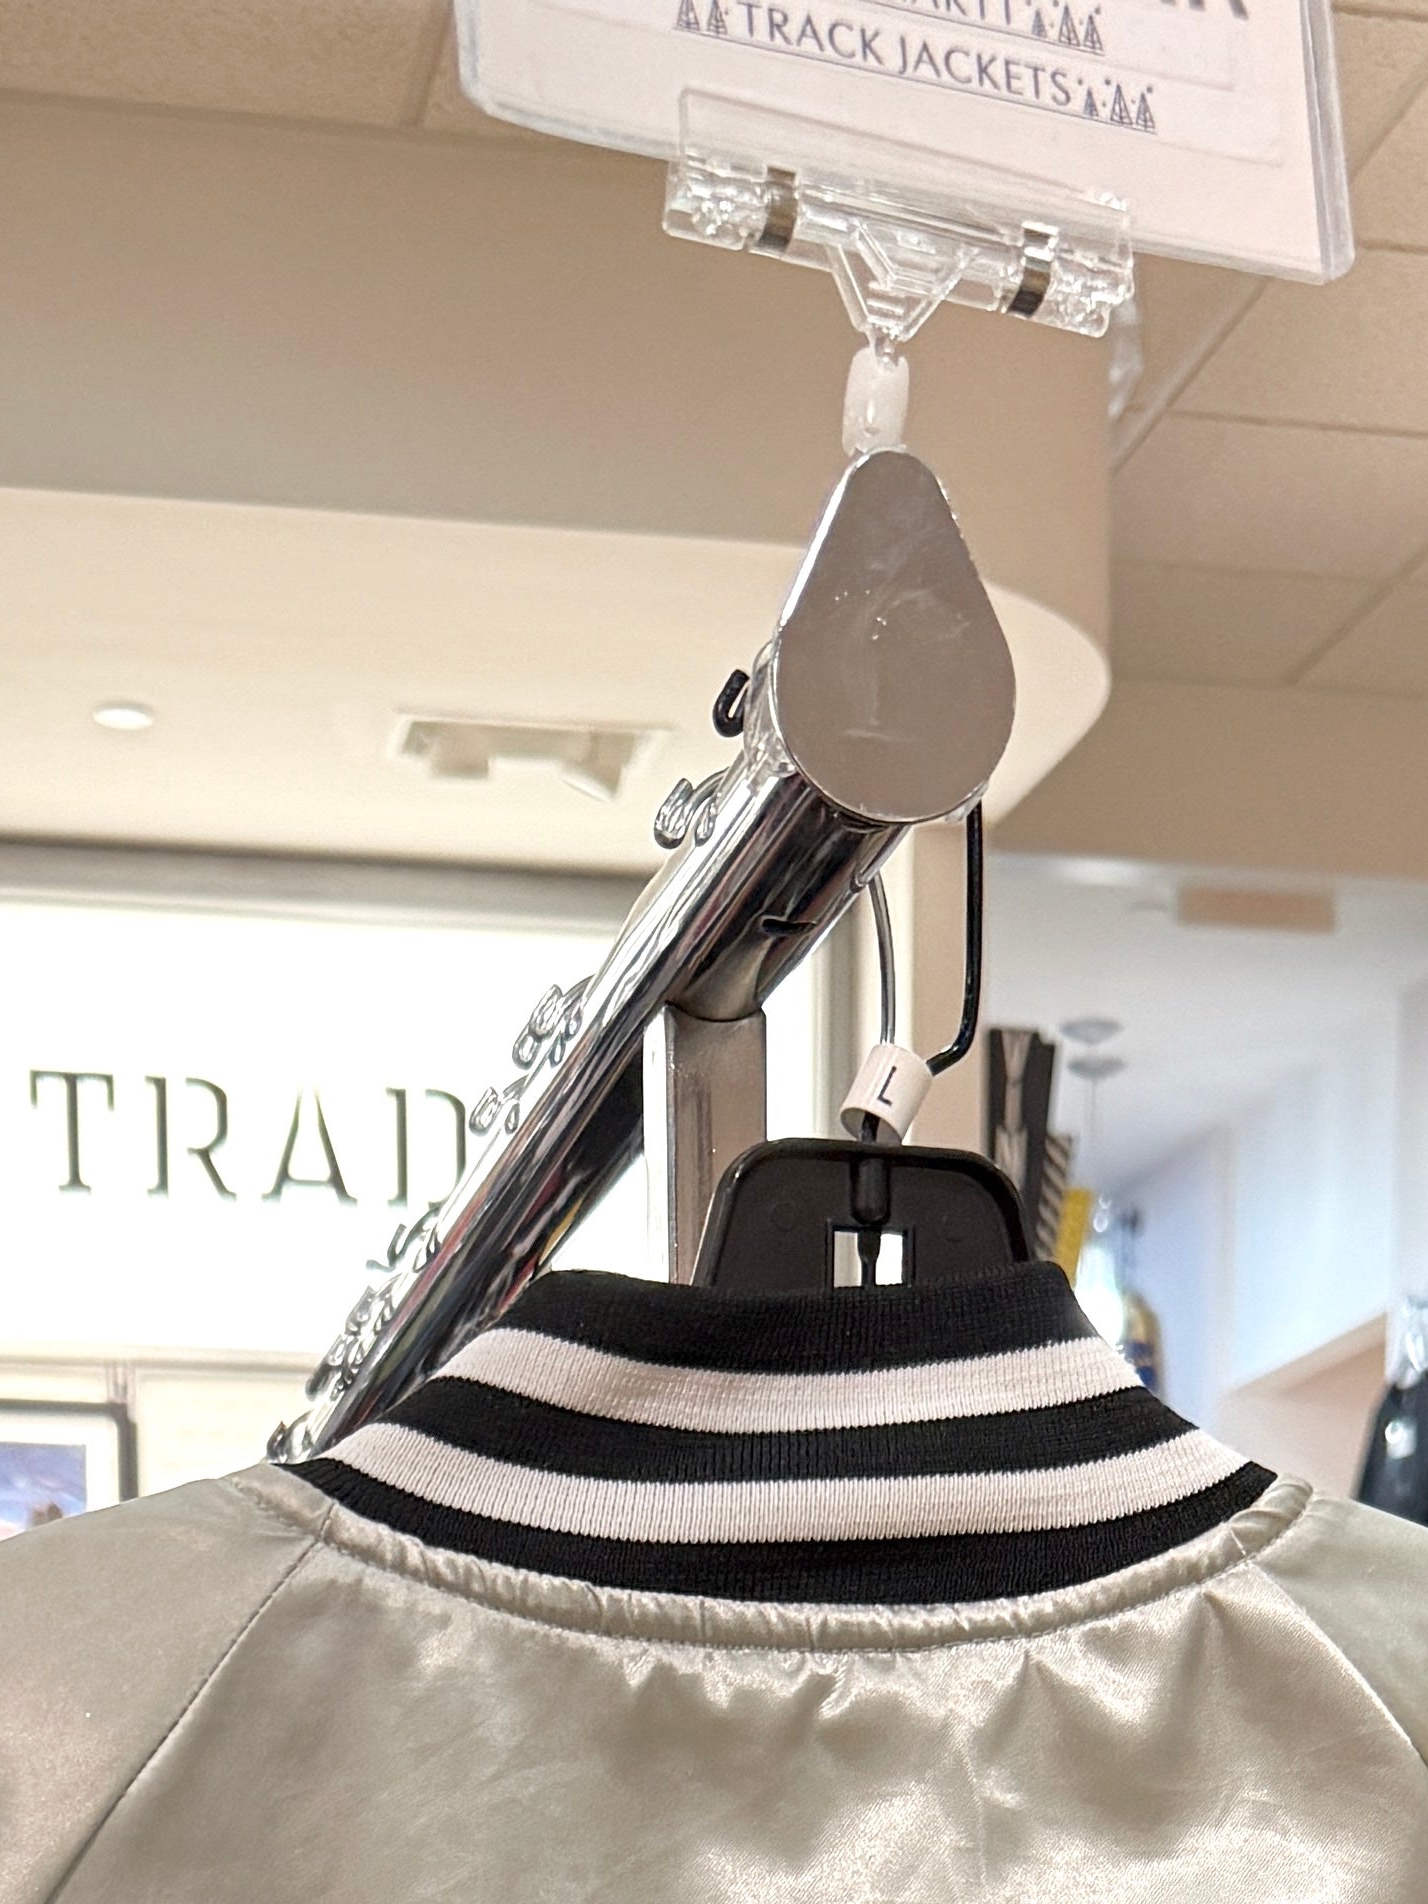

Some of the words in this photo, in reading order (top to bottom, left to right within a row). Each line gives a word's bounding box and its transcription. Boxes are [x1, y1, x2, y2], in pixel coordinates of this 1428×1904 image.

[736, 2, 884, 65] TRACK
[896, 35, 1073, 107] JACKETS
[876, 1065, 897, 1108] L
[29, 1068, 468, 1211] TRAD
